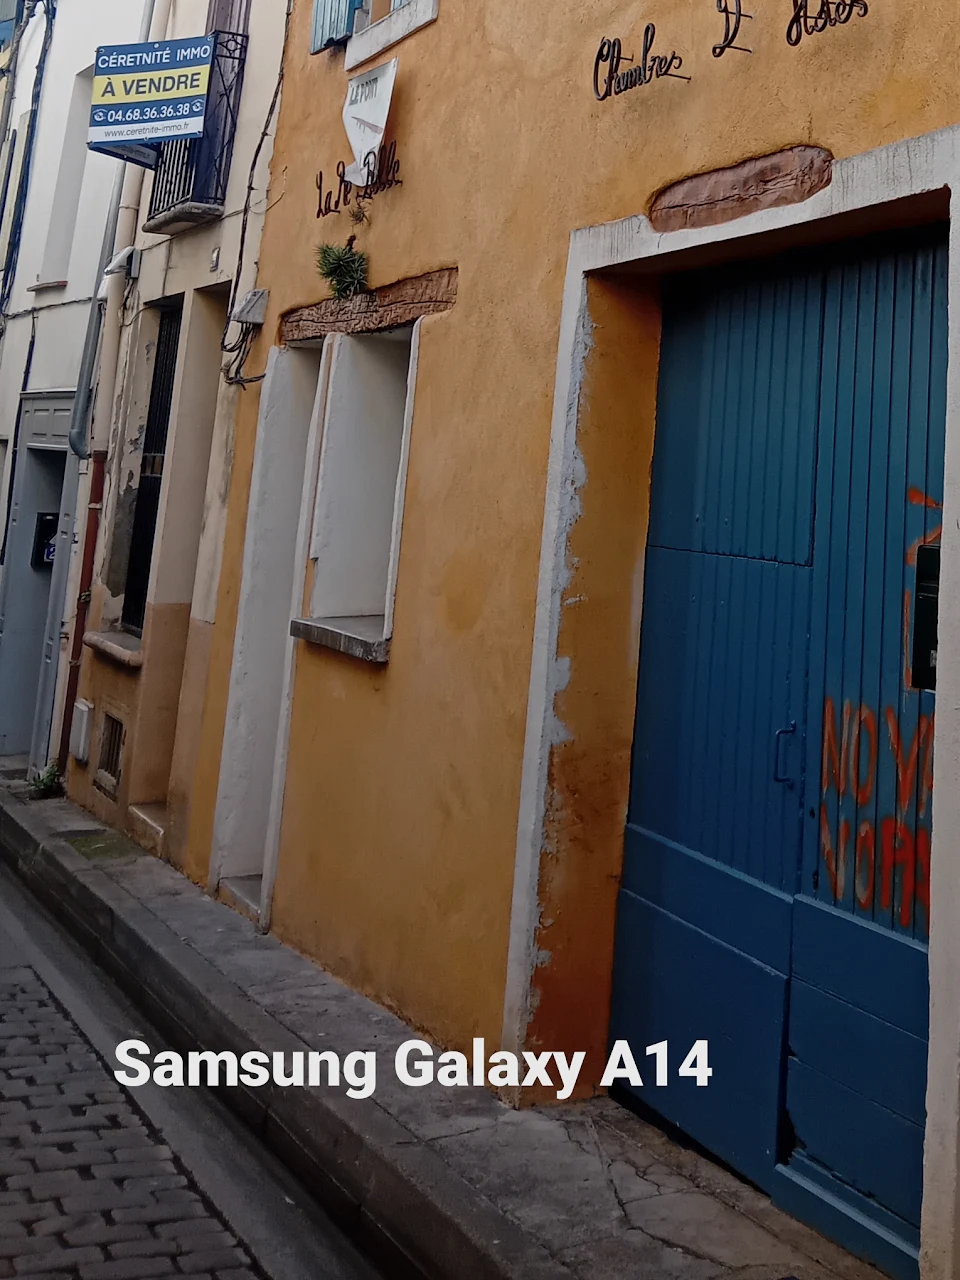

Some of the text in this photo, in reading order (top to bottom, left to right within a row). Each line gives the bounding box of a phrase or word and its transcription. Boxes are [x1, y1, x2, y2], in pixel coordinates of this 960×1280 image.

[98, 45, 211, 68] CÉRETNITÉ IMMO
[593, 22, 684, 102] Chambres
[101, 72, 201, 97] À VENDRE
[107, 103, 190, 123] 04.68.36.36.38
[104, 122, 190, 137] www.ceretnite-immo.fr
[316, 171, 336, 219] La
